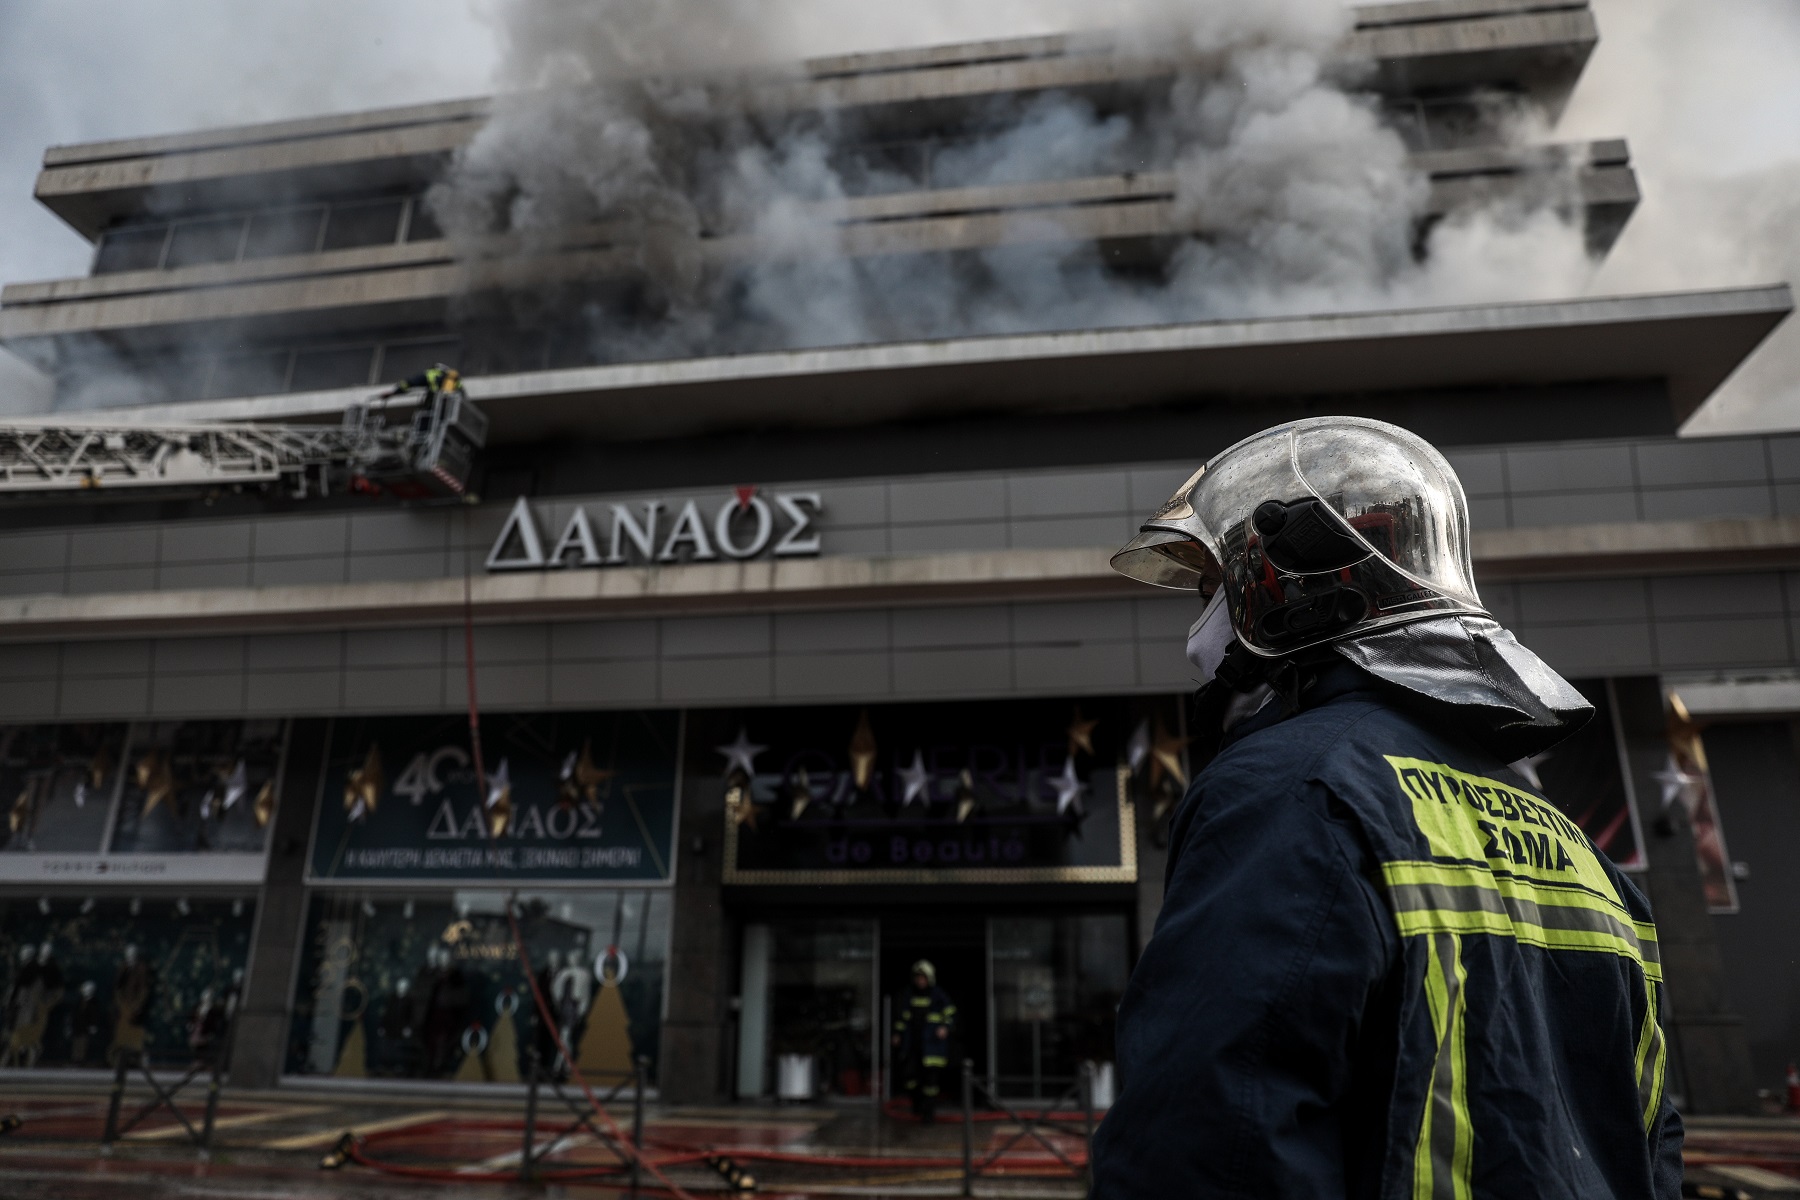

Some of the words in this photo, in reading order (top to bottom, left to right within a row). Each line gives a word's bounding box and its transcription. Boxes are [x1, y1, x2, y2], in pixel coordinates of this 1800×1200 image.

[485, 492, 822, 570] ΔΑΝΑΟΣ
[825, 832, 873, 864] de
[889, 829, 1026, 863] Beauté
[1477, 820, 1579, 874] ΣΩΜΑ
